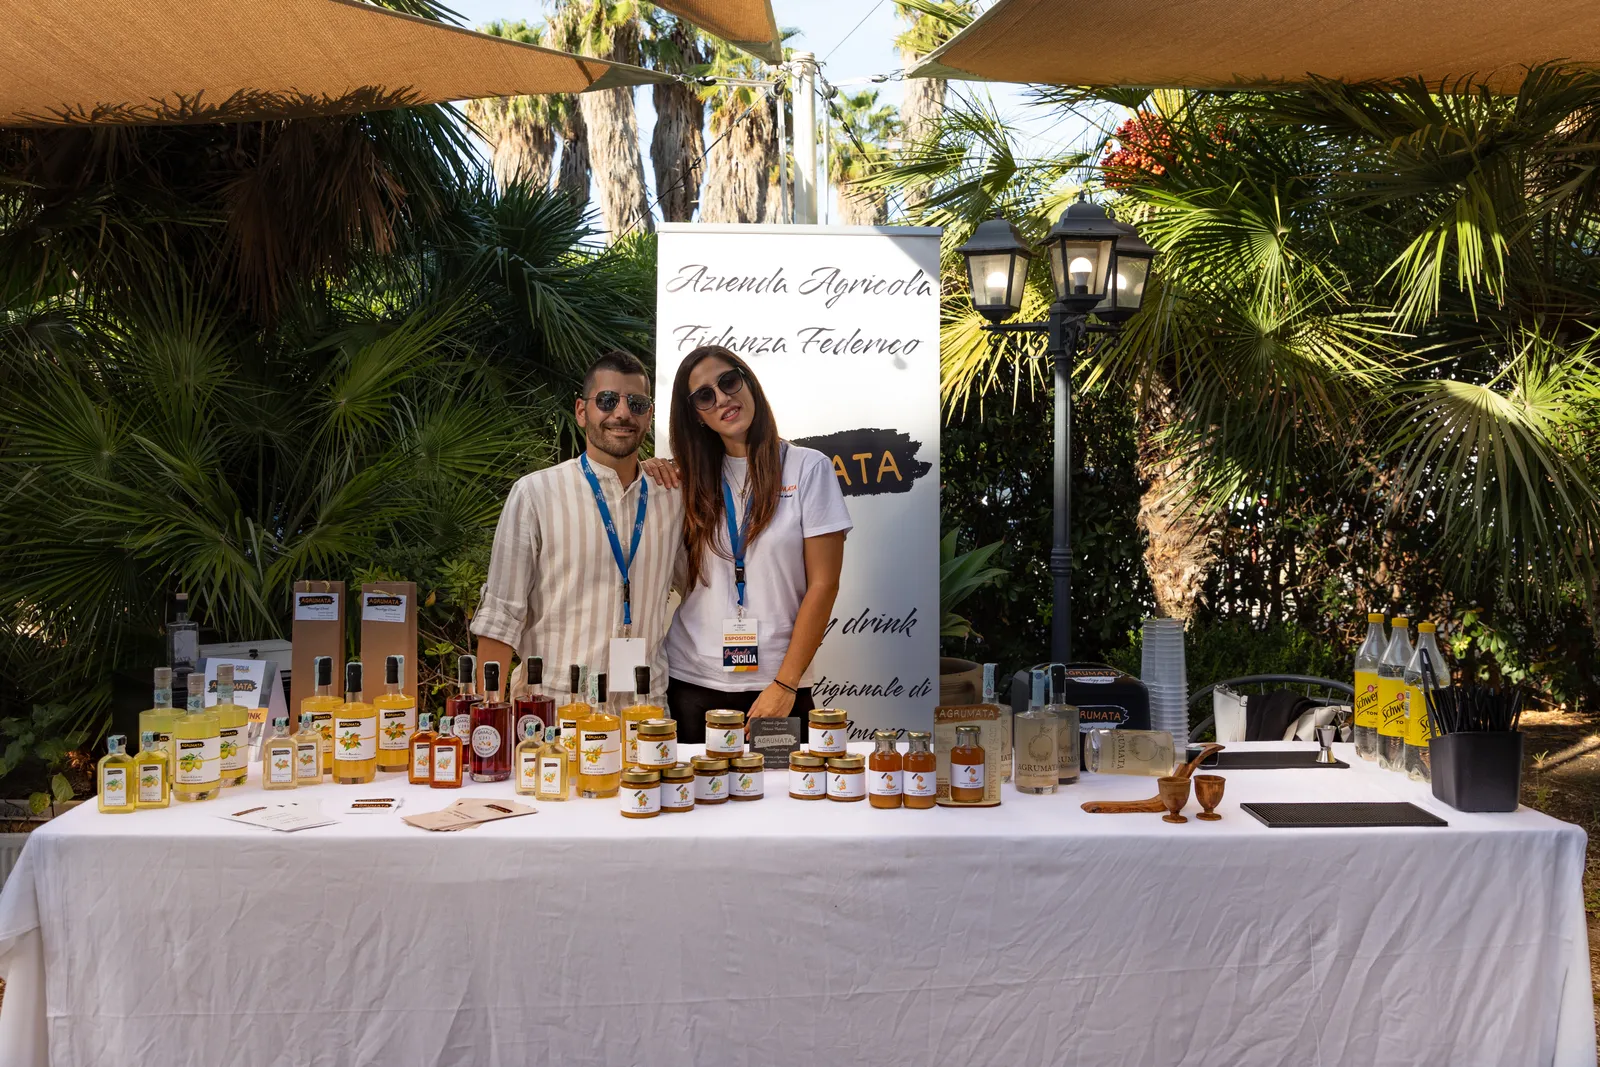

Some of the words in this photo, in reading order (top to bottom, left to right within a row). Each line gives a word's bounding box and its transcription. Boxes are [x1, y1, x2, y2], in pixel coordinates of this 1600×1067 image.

[666, 264, 789, 294] Azienda
[798, 266, 933, 309] Agricola
[672, 324, 788, 354] Fidanza
[797, 326, 924, 356] Federico
[842, 607, 918, 638] drink
[731, 654, 757, 664] SICILIA
[812, 676, 906, 707] tigianale
[909, 678, 932, 698] di
[939, 709, 996, 719] AGRUMATA
[1080, 710, 1121, 720] RUMATA
